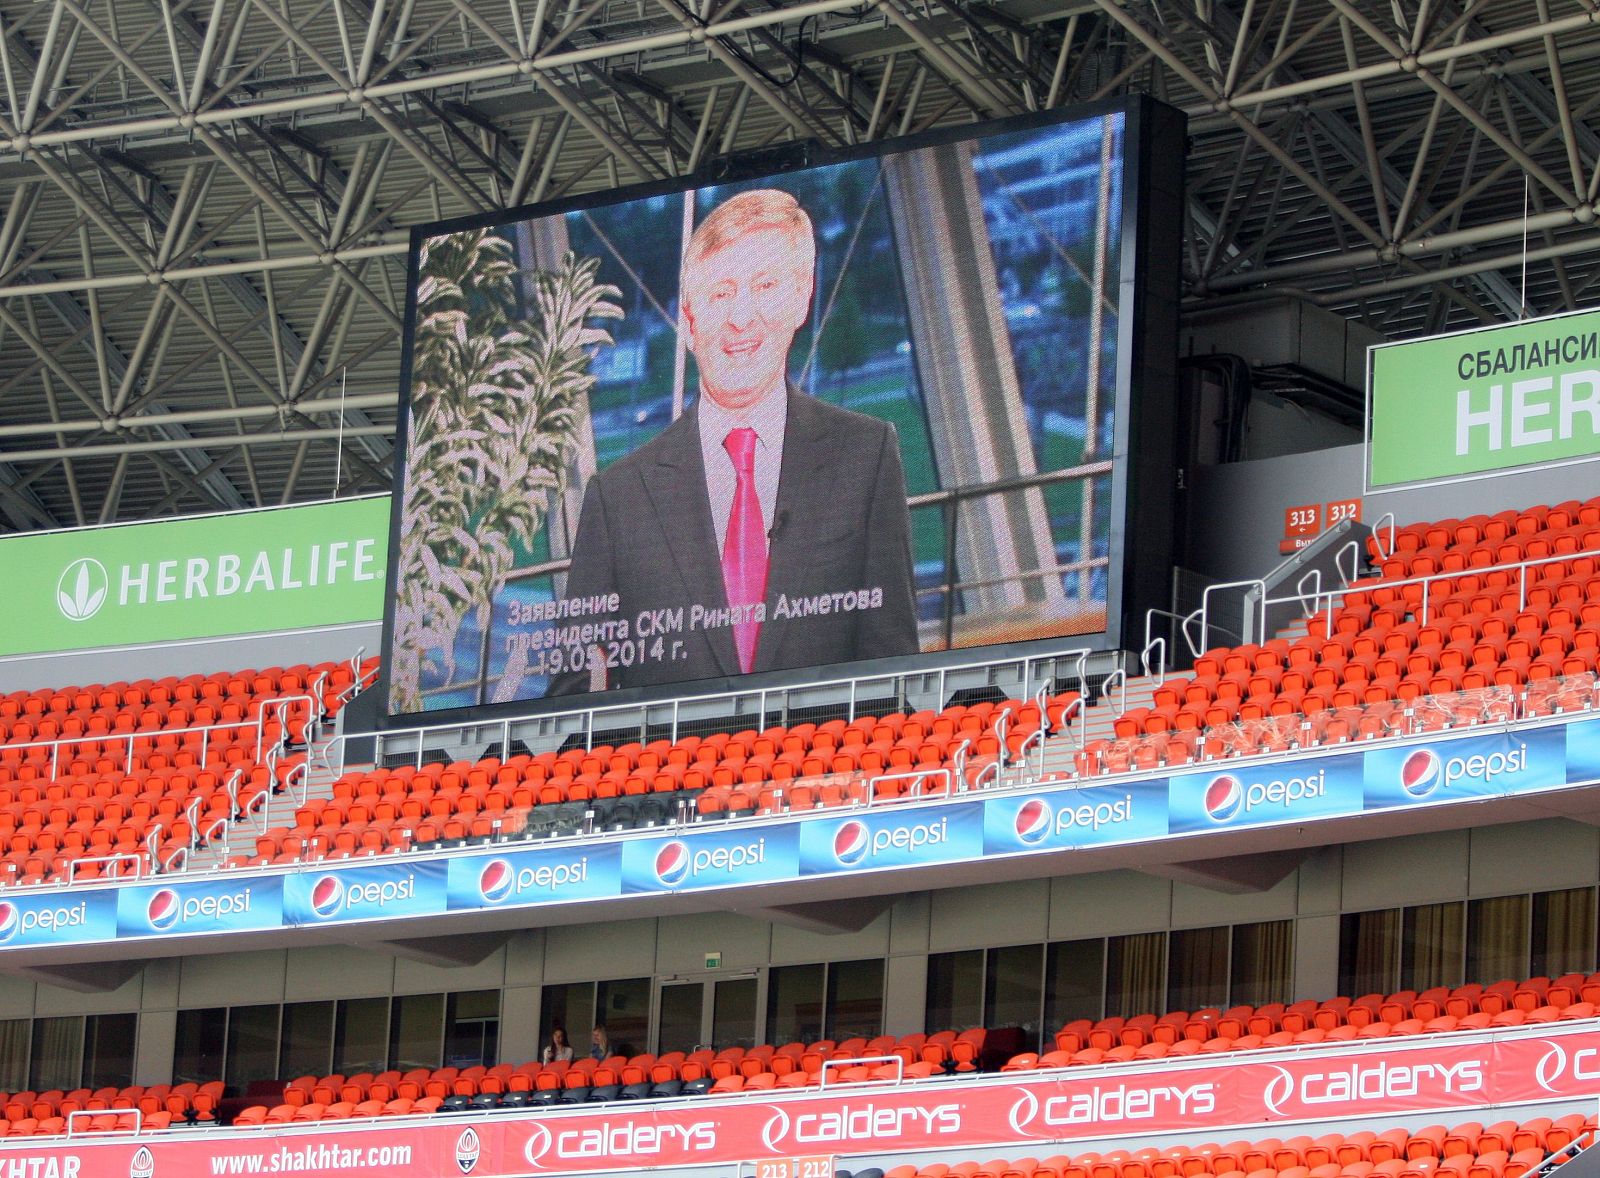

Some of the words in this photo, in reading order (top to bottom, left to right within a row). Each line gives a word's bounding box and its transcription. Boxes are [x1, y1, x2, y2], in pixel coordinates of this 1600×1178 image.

[1457, 332, 1600, 382] СБАЛАНСИ
[1455, 370, 1600, 456] HER
[1290, 509, 1316, 527] 313
[1330, 503, 1357, 521] 312
[505, 619, 630, 653] президента
[636, 606, 685, 638] СКМ
[690, 603, 767, 631] Рината
[773, 586, 883, 621] Ахметова
[507, 592, 620, 626] Заявление
[538, 636, 665, 676] 19.052014
[672, 639, 688, 661] г.
[1444, 743, 1528, 786] pepsi
[1245, 769, 1326, 811] pepsi
[1054, 794, 1133, 835] pepsi
[872, 816, 948, 855] pepsi
[516, 857, 588, 894] pepsi
[692, 838, 766, 877] pepsi
[183, 889, 252, 922] pepsi
[346, 874, 416, 909] pepsi
[20, 901, 87, 935] pepsi
[210, 1143, 413, 1176] www.shakhtar.com
[762, 1163, 788, 1178] 213
[803, 1161, 829, 1178] 212
